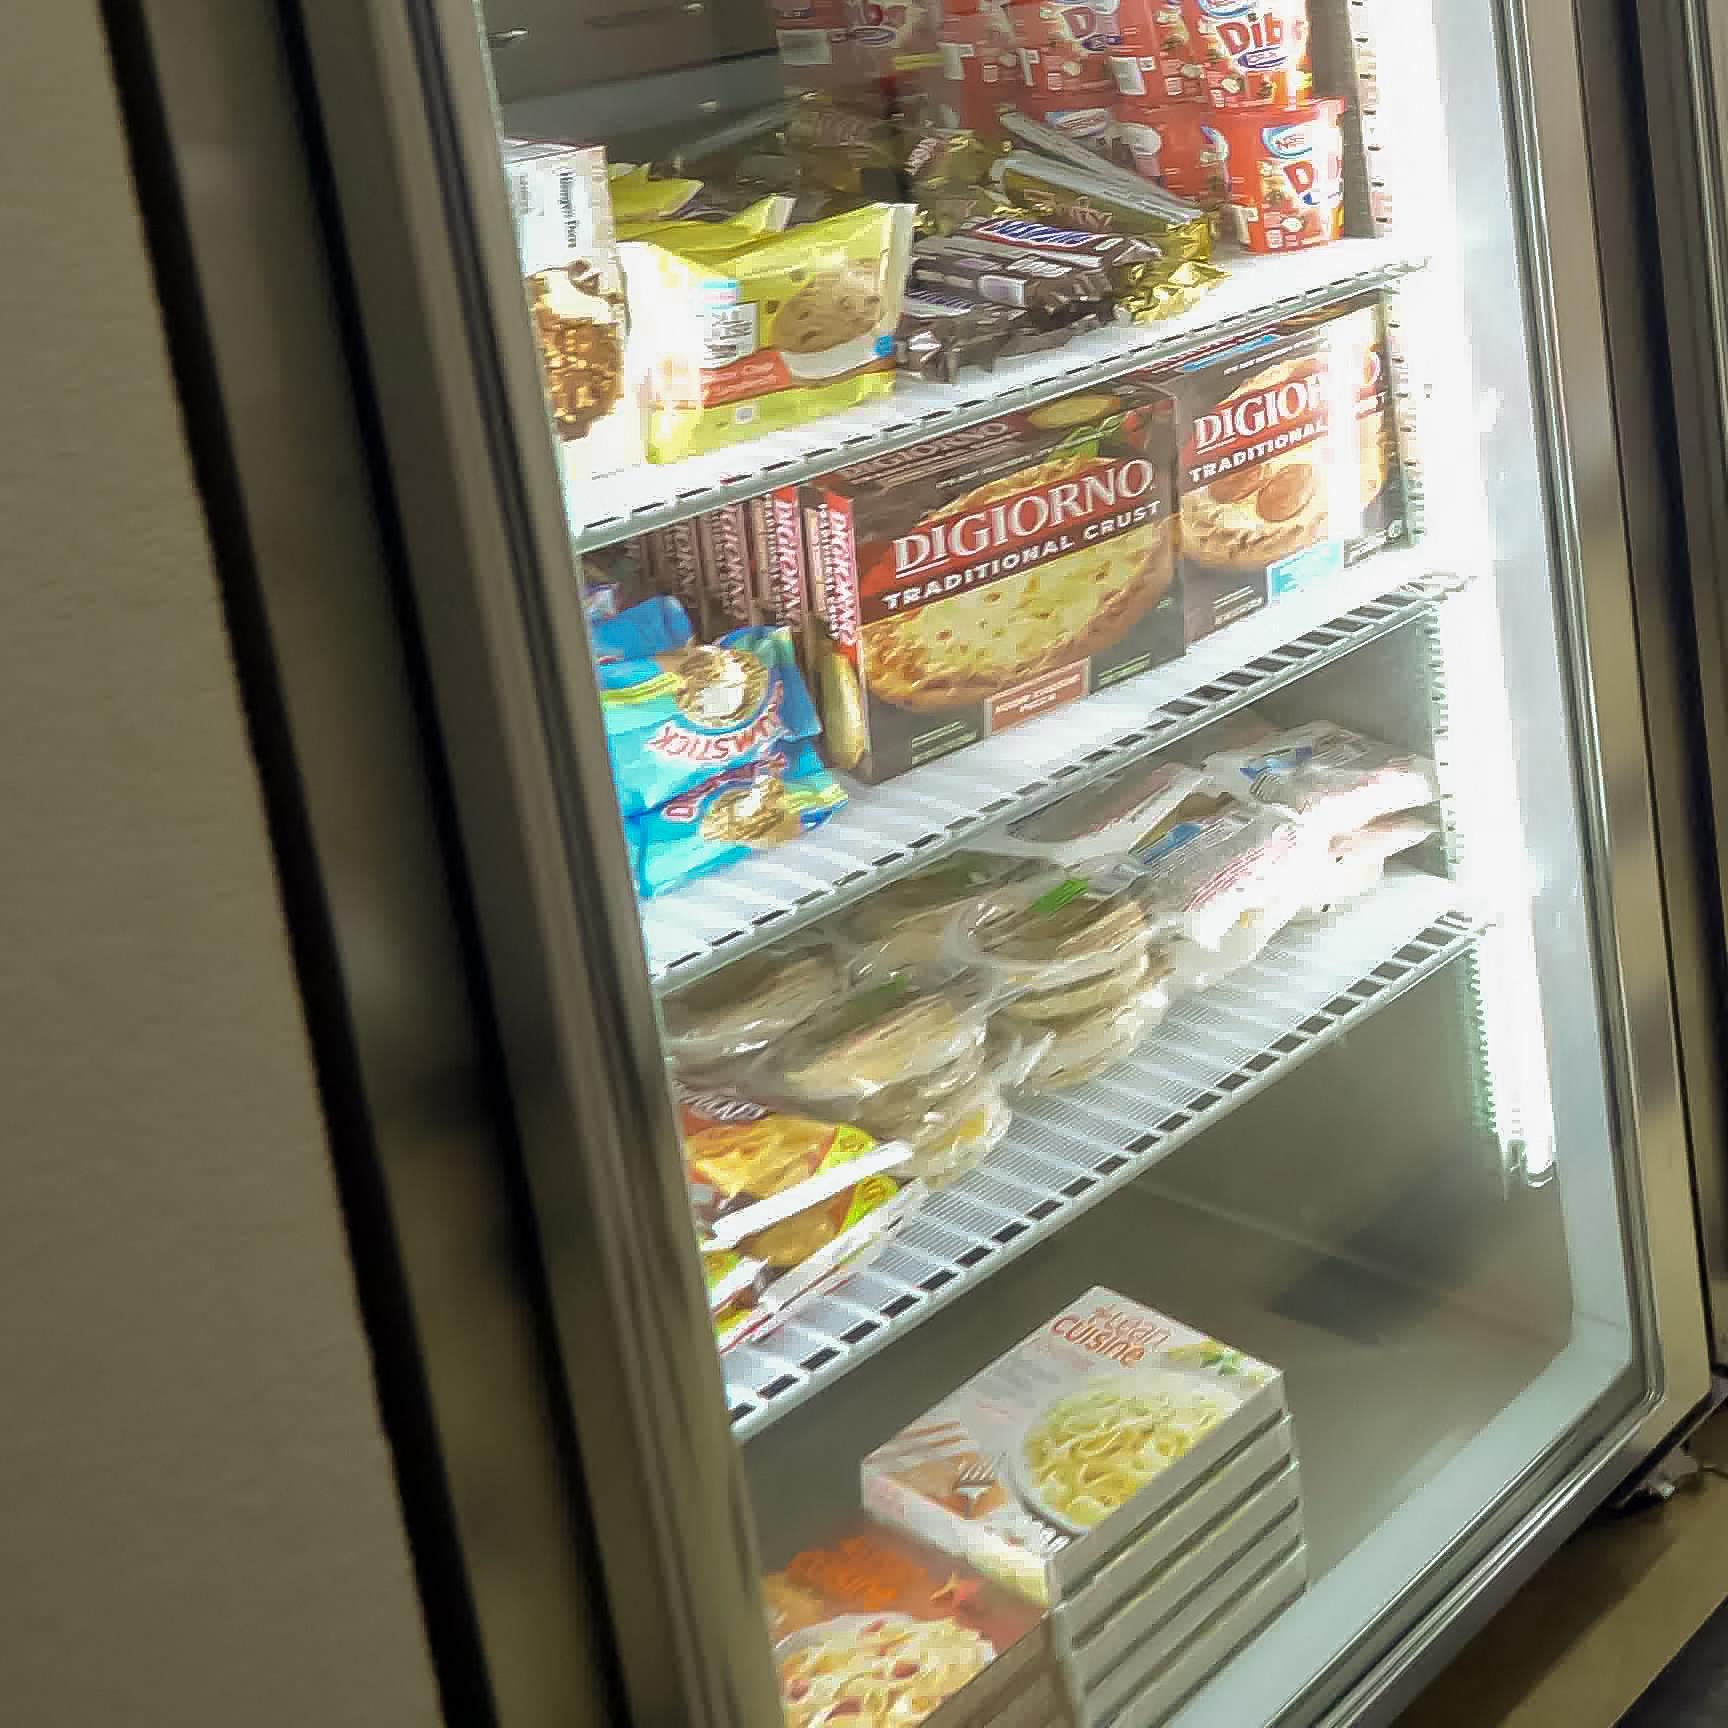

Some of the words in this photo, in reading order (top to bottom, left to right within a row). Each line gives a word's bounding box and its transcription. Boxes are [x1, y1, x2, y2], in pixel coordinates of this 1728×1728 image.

[881, 534, 1074, 610] TRADITIONAL
[1083, 501, 1161, 541] CRUST
[892, 459, 1154, 574] DIGIORNO
